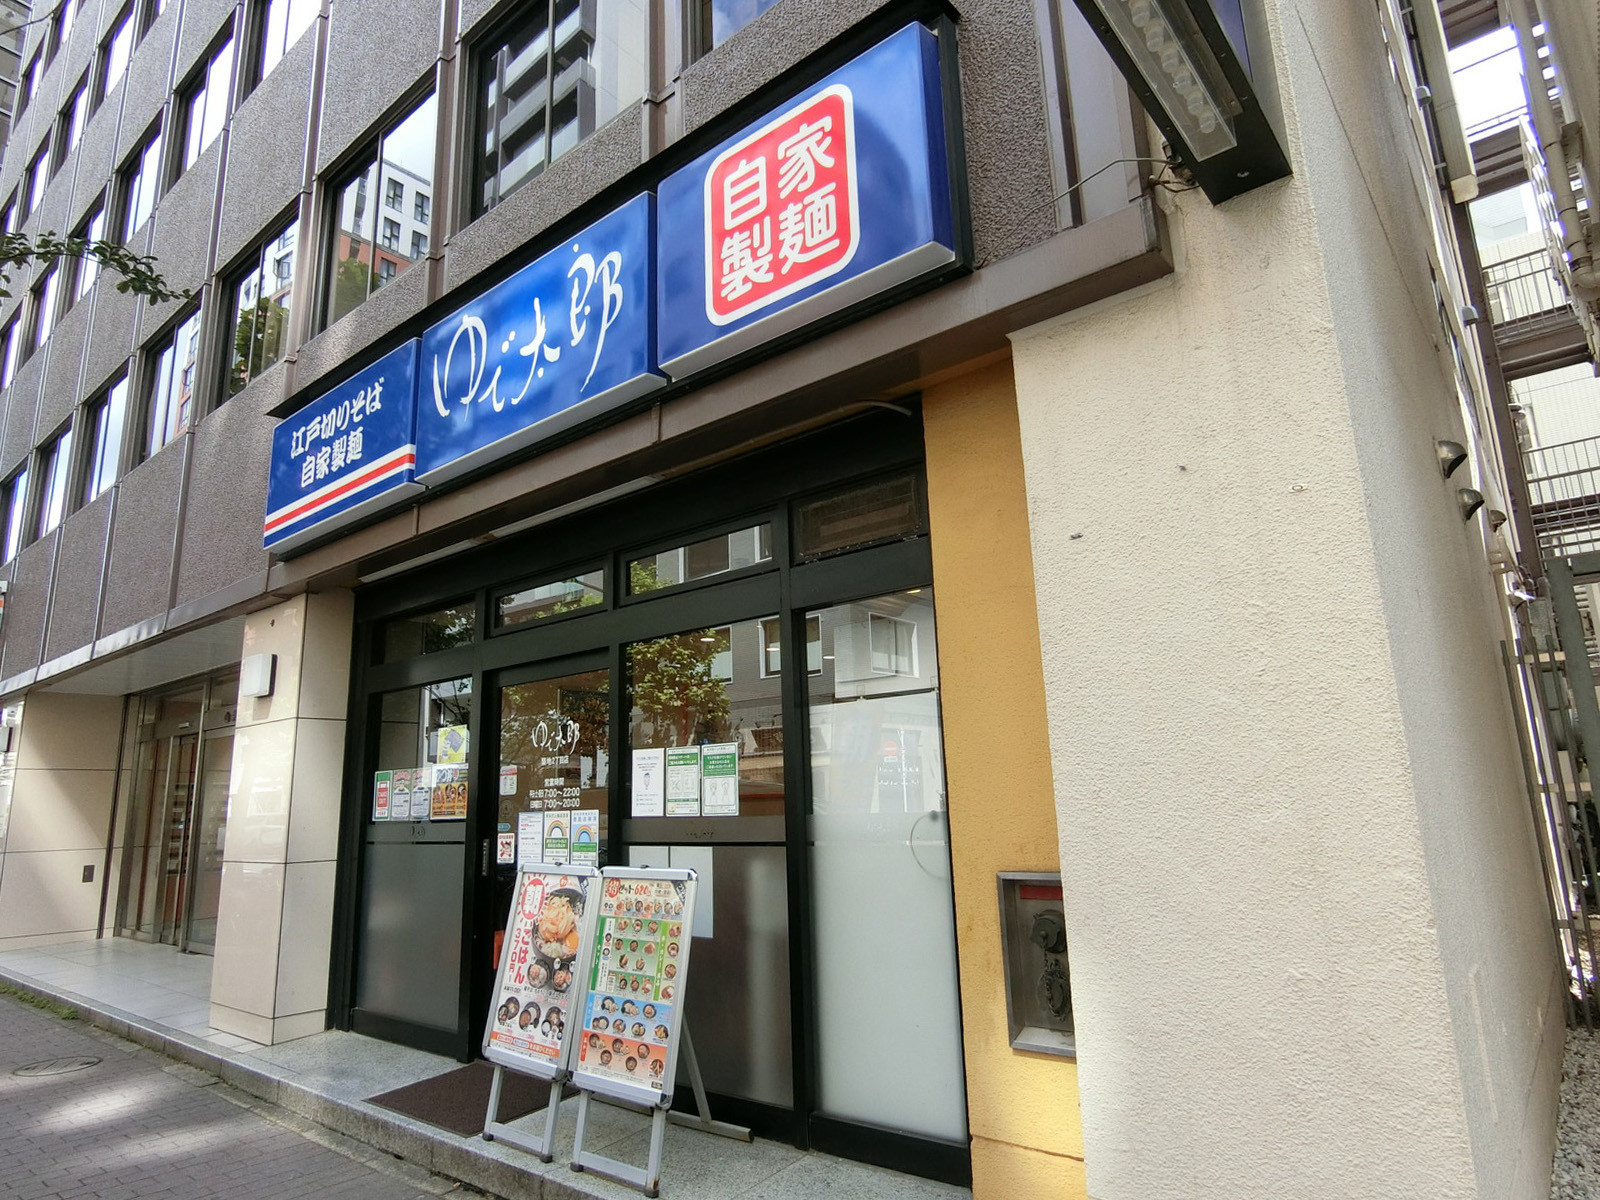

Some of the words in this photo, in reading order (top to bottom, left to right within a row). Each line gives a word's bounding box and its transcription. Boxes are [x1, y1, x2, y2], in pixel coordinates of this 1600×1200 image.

[433, 243, 623, 422] ゆで太郎
[290, 377, 385, 460] 江戸切りそば
[301, 426, 364, 488] 自家製麺
[532, 720, 580, 754] ゆで太郎
[544, 777, 565, 787] 営業時間
